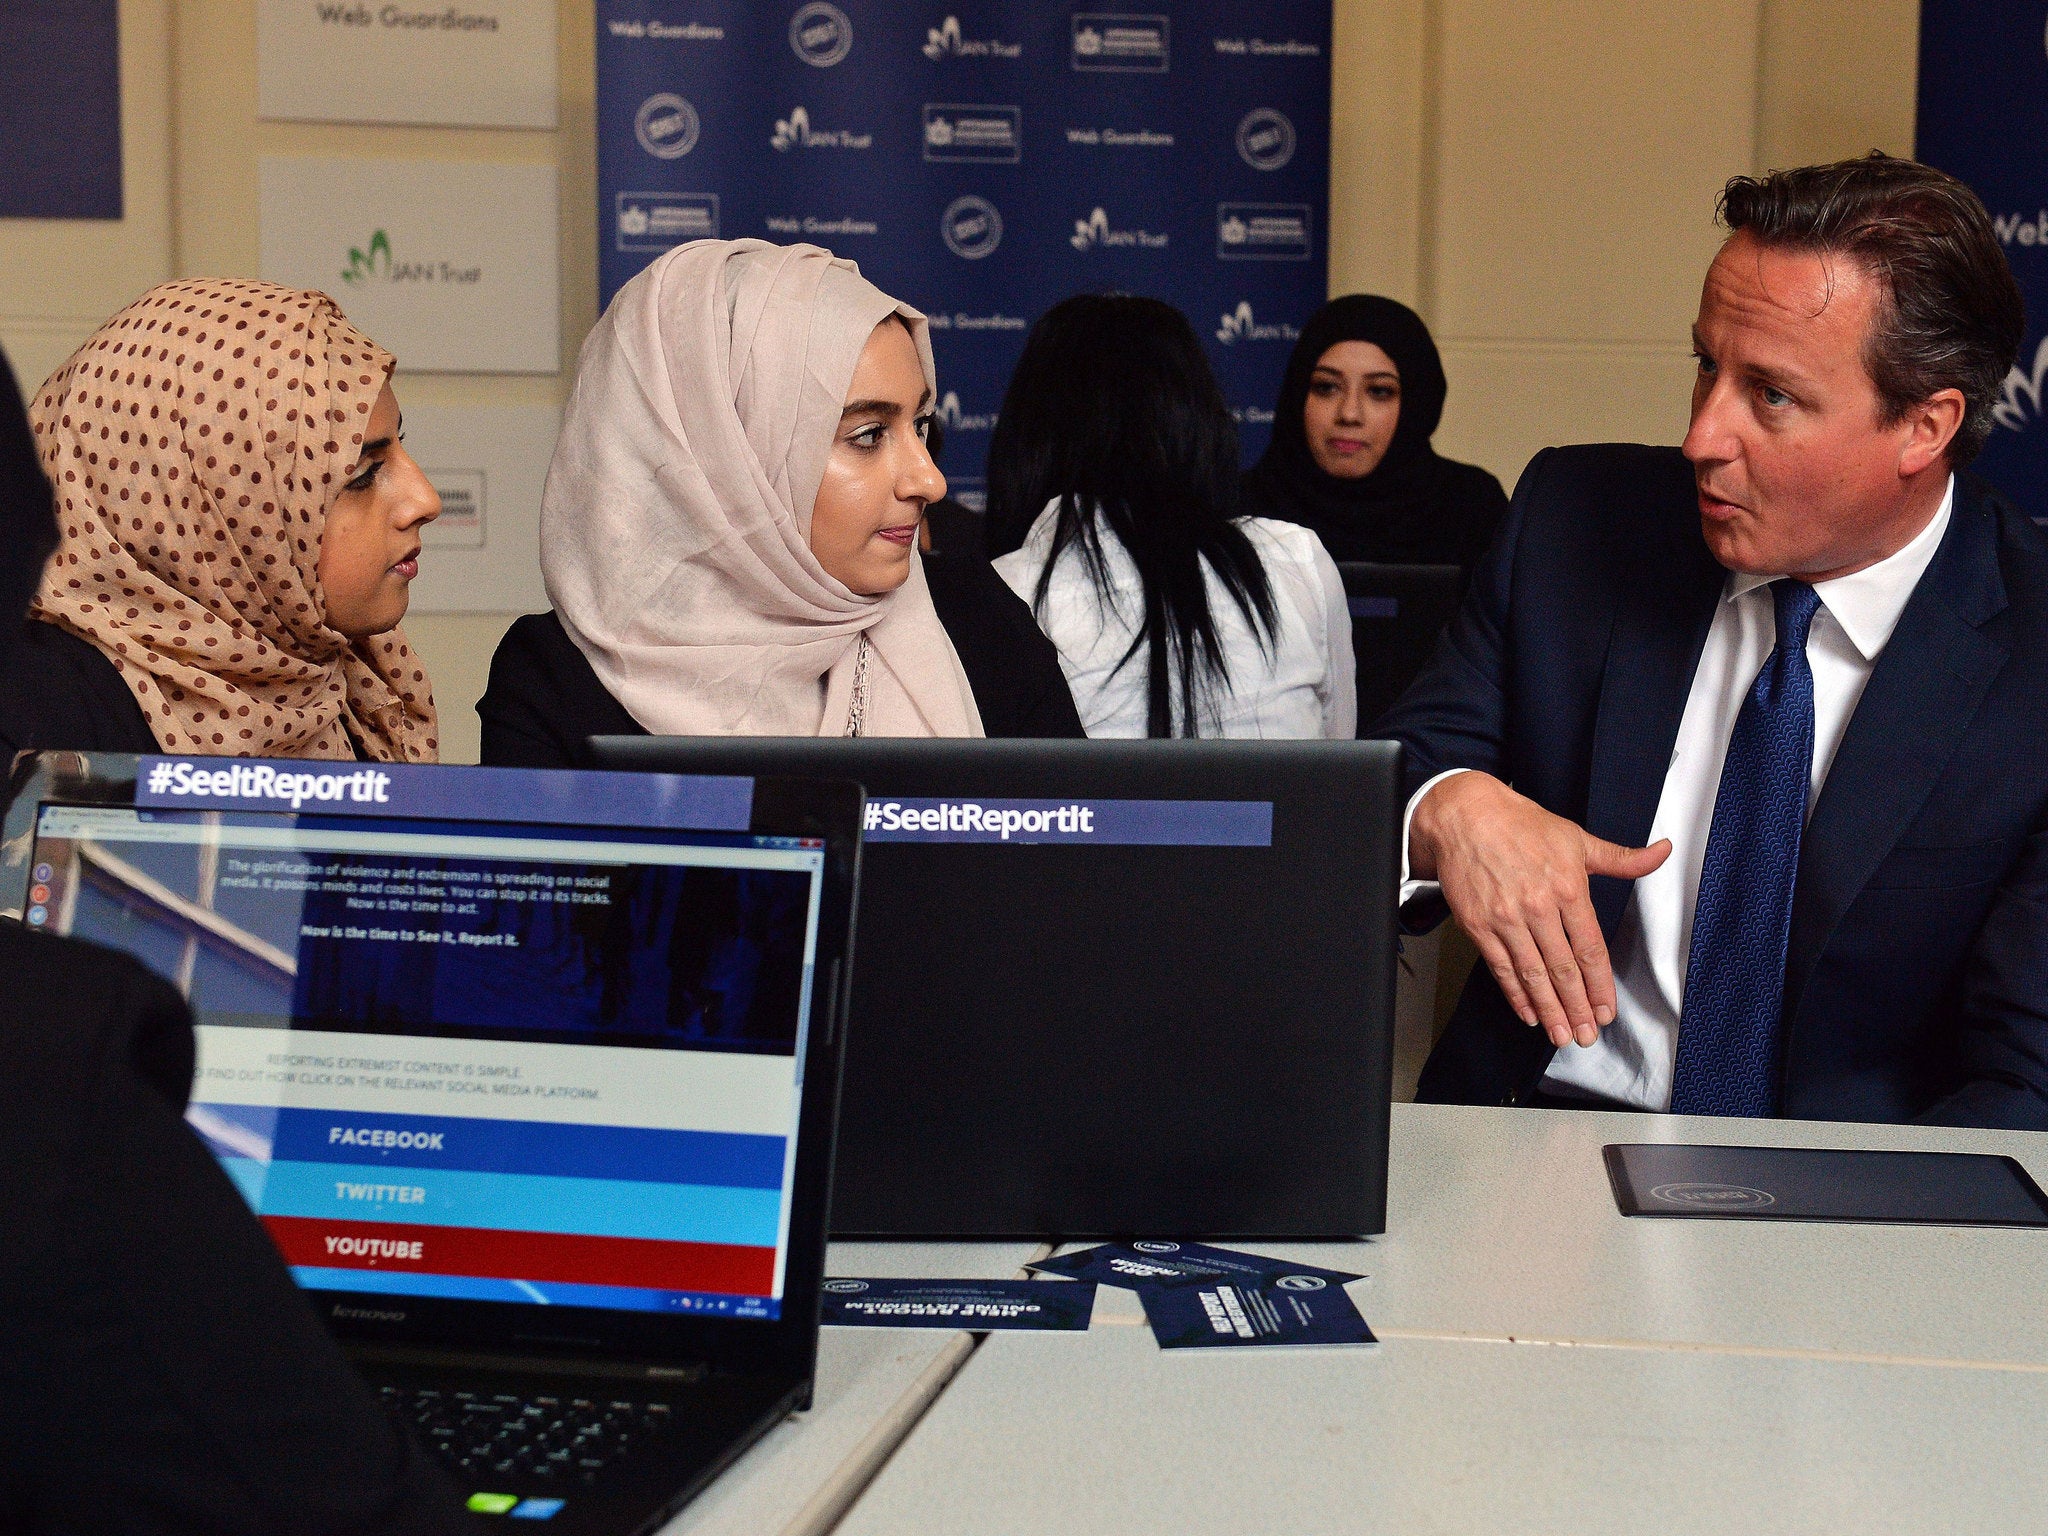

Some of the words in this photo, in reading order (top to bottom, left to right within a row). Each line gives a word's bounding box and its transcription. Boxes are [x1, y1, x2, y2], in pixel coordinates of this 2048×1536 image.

[316, 3, 372, 27] Web
[379, 4, 499, 32] Guardians
[148, 762, 391, 809] #SeeItReportIt
[862, 802, 1094, 839] #SeeItReportIt
[325, 863, 340, 875] of
[340, 865, 392, 878] violence
[393, 867, 415, 879] and
[416, 869, 481, 882] extremism
[494, 871, 555, 888] spreading
[556, 875, 573, 886] on
[574, 875, 610, 888] social
[322, 881, 358, 893] minds
[359, 881, 383, 894] and
[384, 883, 415, 896] costs
[450, 886, 474, 899] You
[476, 888, 498, 900] can
[499, 888, 528, 902] stop
[346, 898, 376, 909] Now
[388, 899, 410, 911] the
[412, 900, 440, 913] time
[441, 902, 456, 913] to
[301, 924, 331, 938] Now
[332, 926, 343, 938] is
[344, 926, 367, 939] the
[368, 927, 398, 941] time
[400, 929, 415, 942] to
[416, 930, 441, 943] See
[458, 931, 504, 949] Report
[267, 1053, 334, 1068] REPORTING
[337, 1057, 401, 1072] EXTREMIST
[404, 1061, 461, 1075] CONTENT
[384, 1077, 442, 1091] RELEVANT
[446, 1080, 488, 1094] SOCIAL
[492, 1083, 530, 1096] MEDIA
[328, 1127, 444, 1150] FACEBOOK
[335, 1181, 426, 1205] TWITTER
[324, 1236, 424, 1260] YOUTUBE
